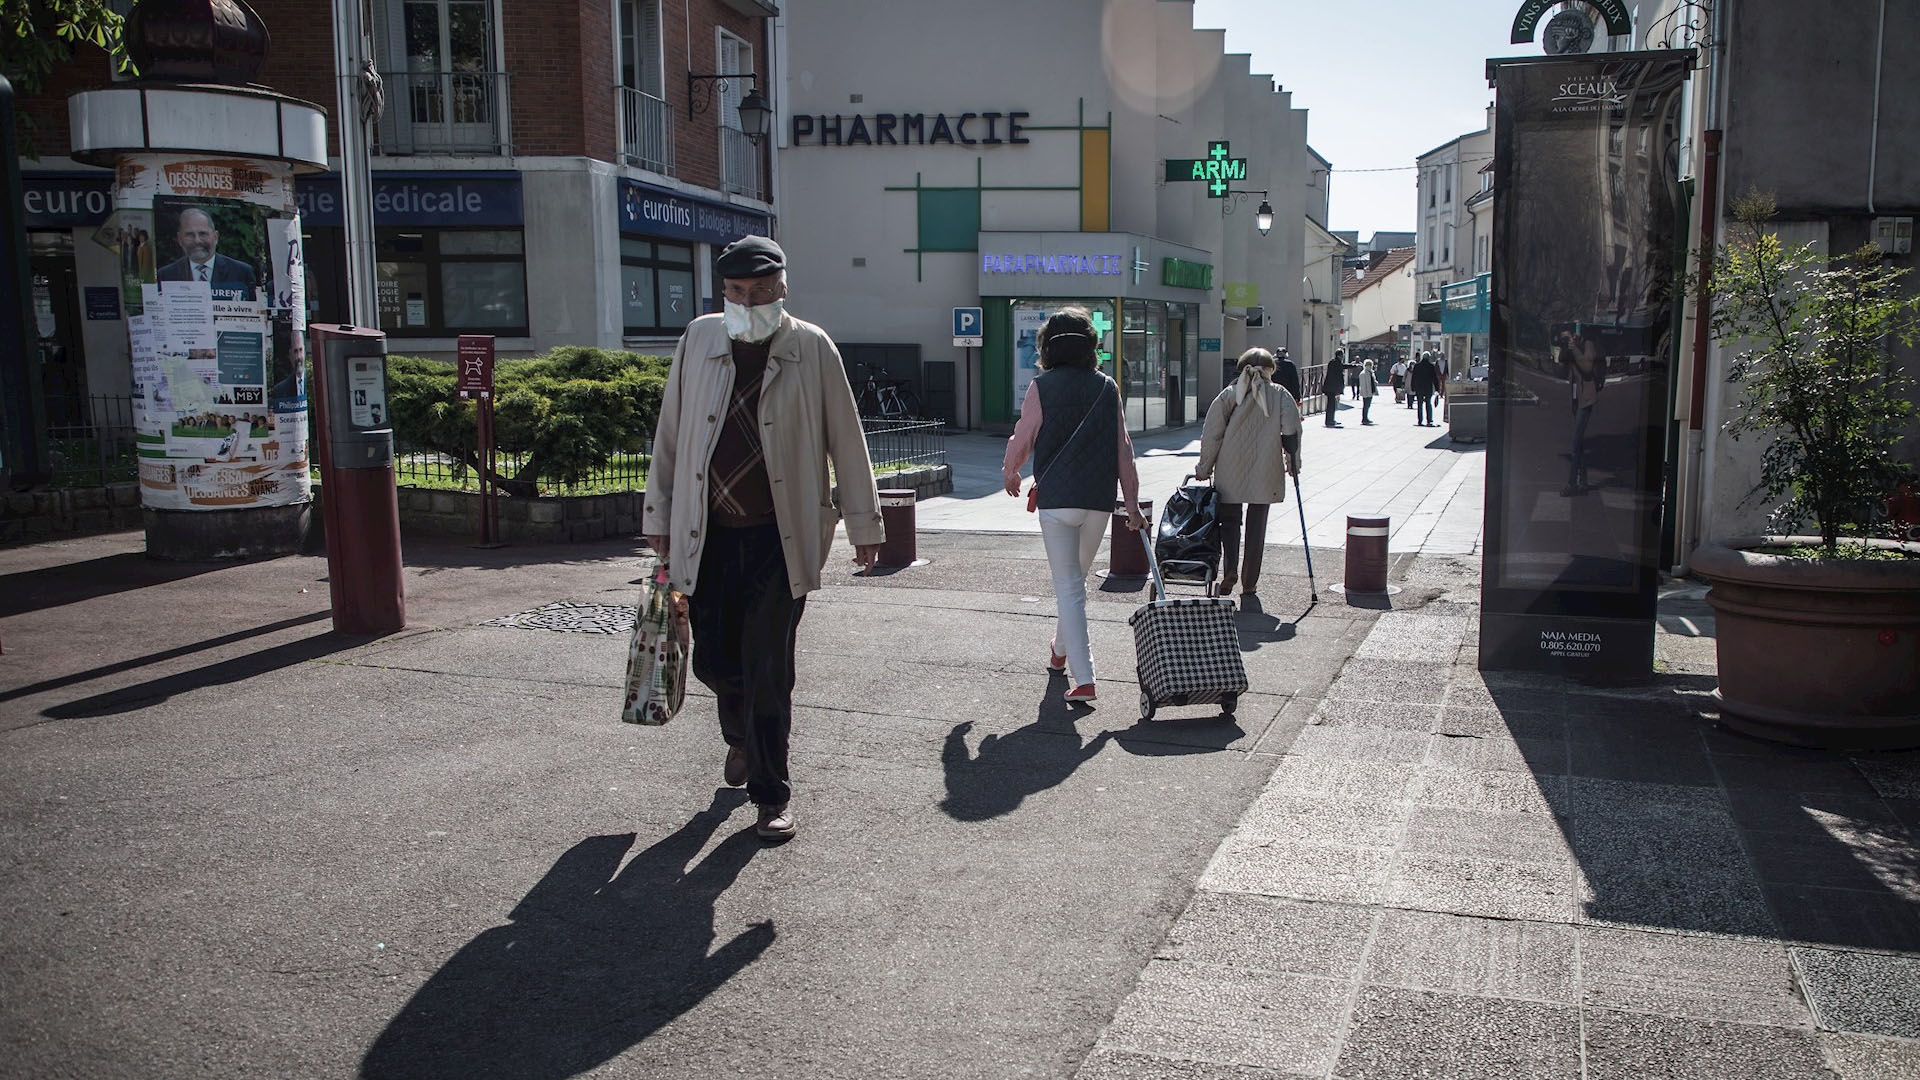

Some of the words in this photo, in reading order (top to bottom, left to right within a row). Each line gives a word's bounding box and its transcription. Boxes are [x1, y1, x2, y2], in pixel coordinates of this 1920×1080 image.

[1518, 2, 1541, 32] VINS
[1559, 81, 1618, 97] SCEAUX
[793, 111, 1030, 146] PHARMACIE
[168, 171, 233, 191] DESSANGES
[233, 180, 264, 195] AVANCE
[643, 198, 690, 227] eurofins
[698, 208, 732, 237] Biologie
[983, 253, 1123, 276] PARAPHARMACIE
[379, 288, 399, 296] OGIE
[234, 305, 252, 313] vivre
[960, 313, 975, 332] P
[1541, 631, 1566, 641] NAJA
[1567, 632, 1601, 642] MEDIA
[1540, 641, 1601, 652] 0.805.620.070
